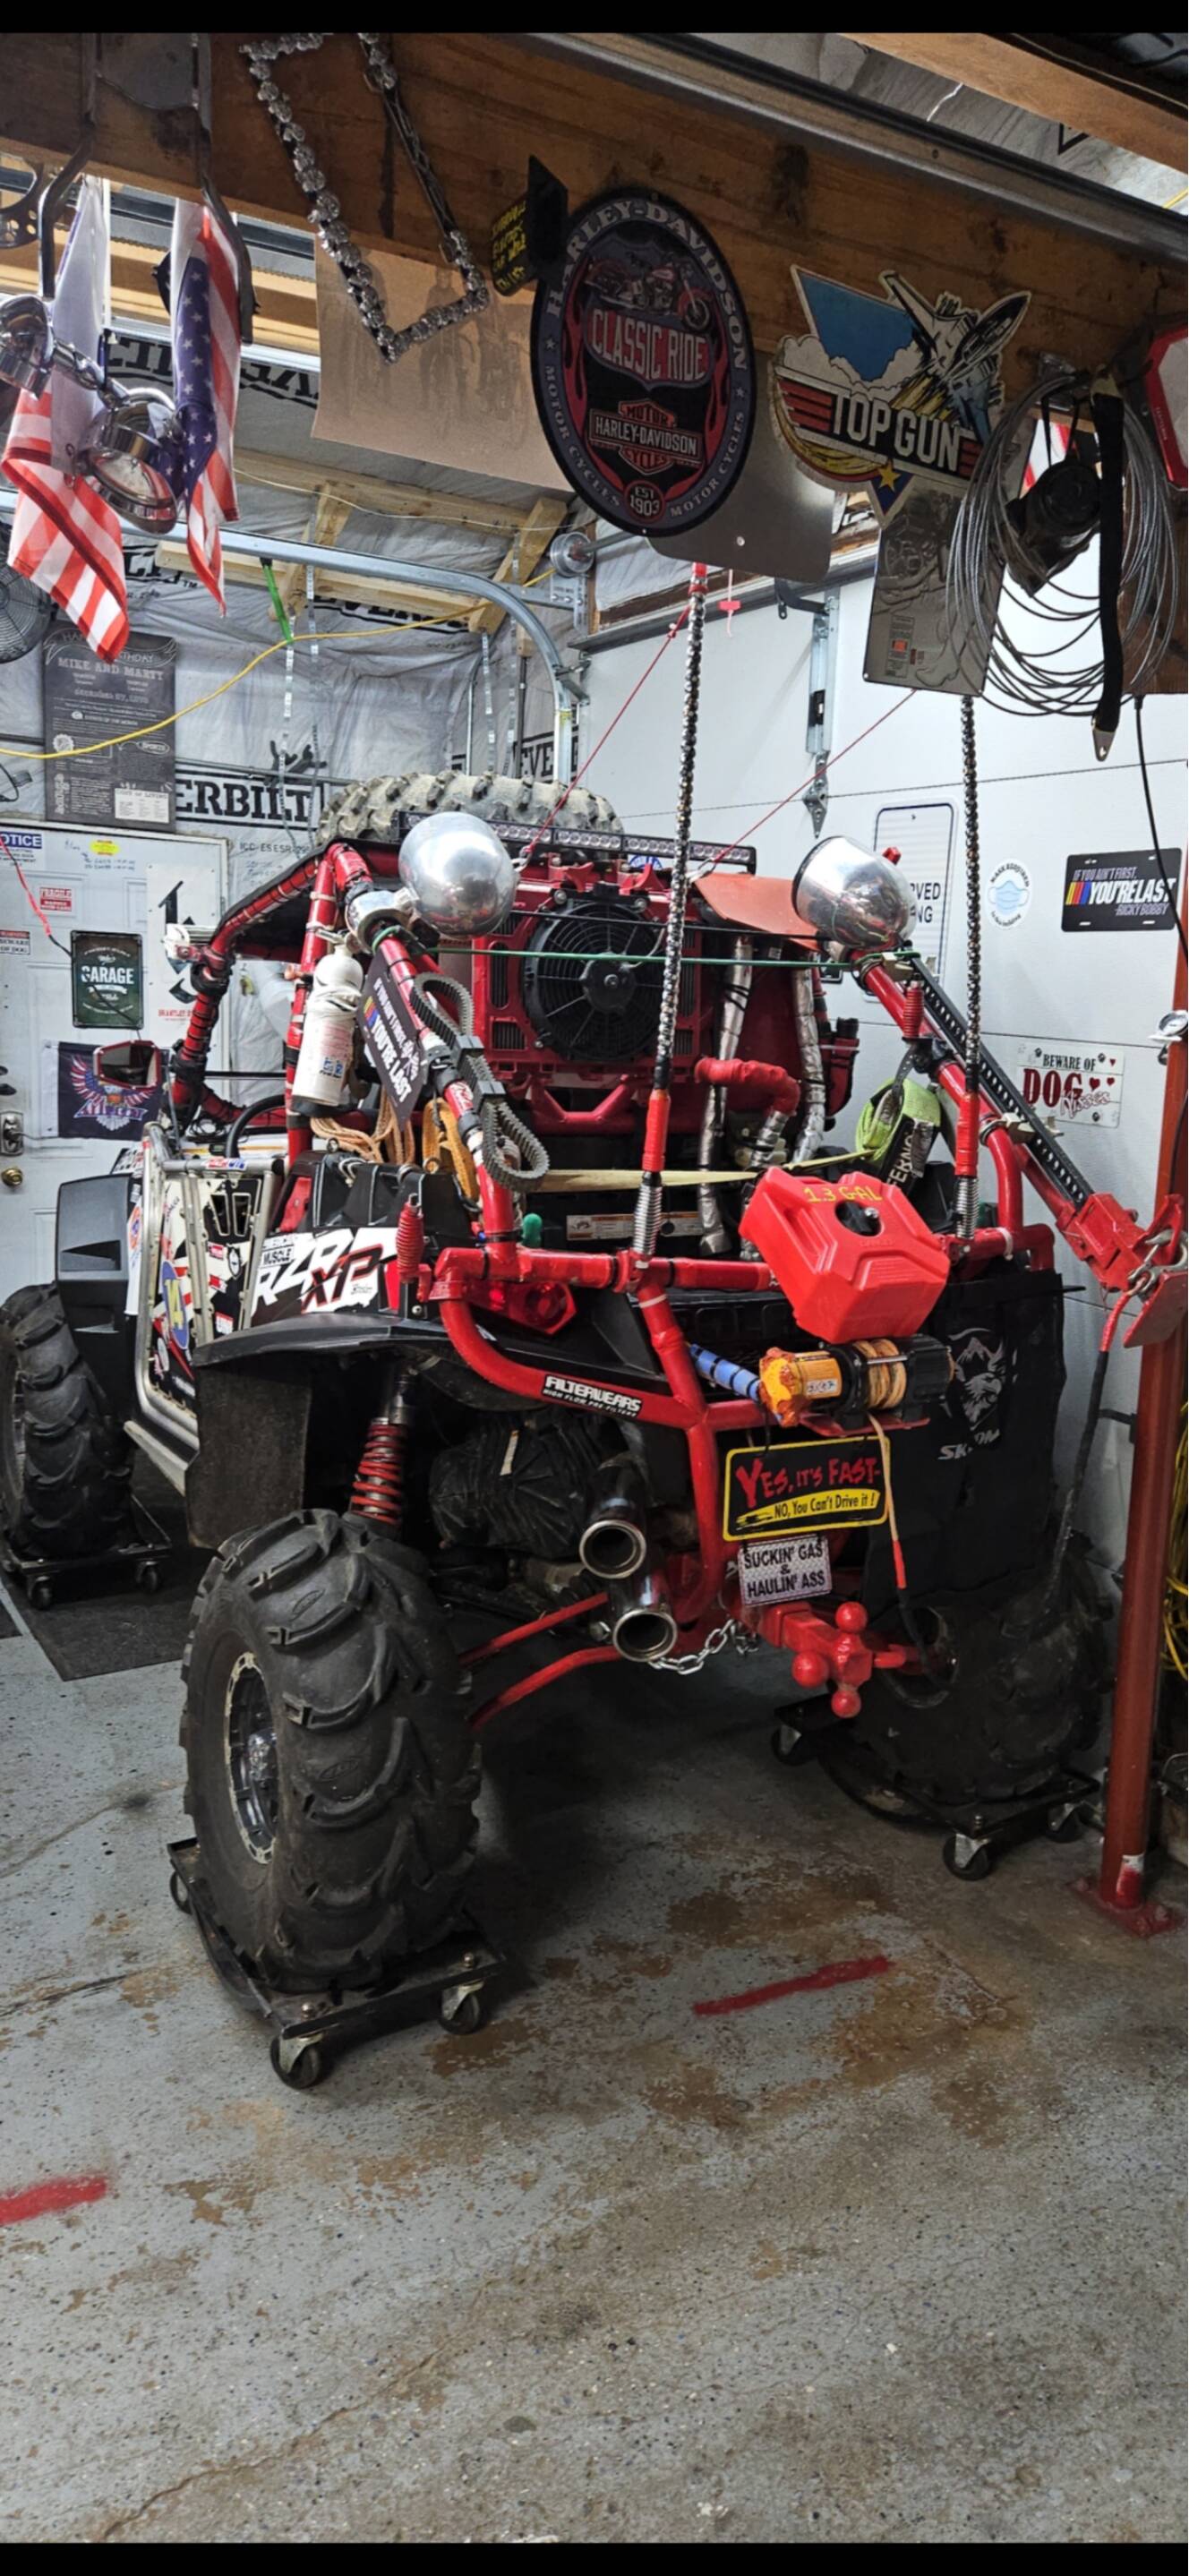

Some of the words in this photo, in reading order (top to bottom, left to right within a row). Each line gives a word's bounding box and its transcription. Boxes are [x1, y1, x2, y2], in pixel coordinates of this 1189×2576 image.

[592, 309, 662, 380] CLASSIC
[670, 330, 706, 381] RIDE
[544, 365, 570, 440] MOTOR
[569, 446, 620, 507] CYCLES
[595, 416, 697, 456] HARLEY-DAVIDSON
[832, 390, 892, 447] TOP
[894, 407, 961, 471] GUN
[671, 478, 720, 518] MOTOR
[719, 413, 744, 475] CYCLES
[629, 496, 660, 517] 1903
[634, 487, 654, 498] EST
[58, 657, 91, 672] MIKE
[95, 662, 119, 674] AND
[124, 666, 164, 680] MARTY
[175, 779, 312, 823] ERBILT
[0, 834, 41, 848] OTICE
[1081, 869, 1097, 881] YOU
[1114, 866, 1137, 879] FIRST,
[1089, 880, 1137, 905] YOU'RE
[1134, 877, 1176, 903] LAST
[1139, 902, 1170, 915] BOBBY
[81, 965, 134, 985] GARAGE
[1043, 1054, 1081, 1070] BEWARE
[1083, 1057, 1096, 1071] OF
[389, 1060, 413, 1102] LAST
[1022, 1068, 1083, 1108] DOG
[804, 1186, 837, 1203] 1.3
[838, 1185, 882, 1202] GAL
[262, 1248, 293, 1265] MUSCLE
[251, 1228, 355, 1318] RZR
[301, 1243, 383, 1314] XP
[545, 1375, 642, 1412] FILTERWEARS
[564, 1394, 587, 1405] FLOW
[735, 1458, 793, 1510] YES,
[774, 1505, 791, 1519] NO,
[792, 1502, 808, 1516] You
[810, 1496, 833, 1512] Can't
[835, 1493, 858, 1510] Drive
[744, 1546, 794, 1570] SUCKIN'
[798, 1542, 823, 1561] GAS
[781, 1563, 791, 1575] &
[748, 1573, 797, 1598] HAULIN'
[801, 1570, 825, 1589] ASS
